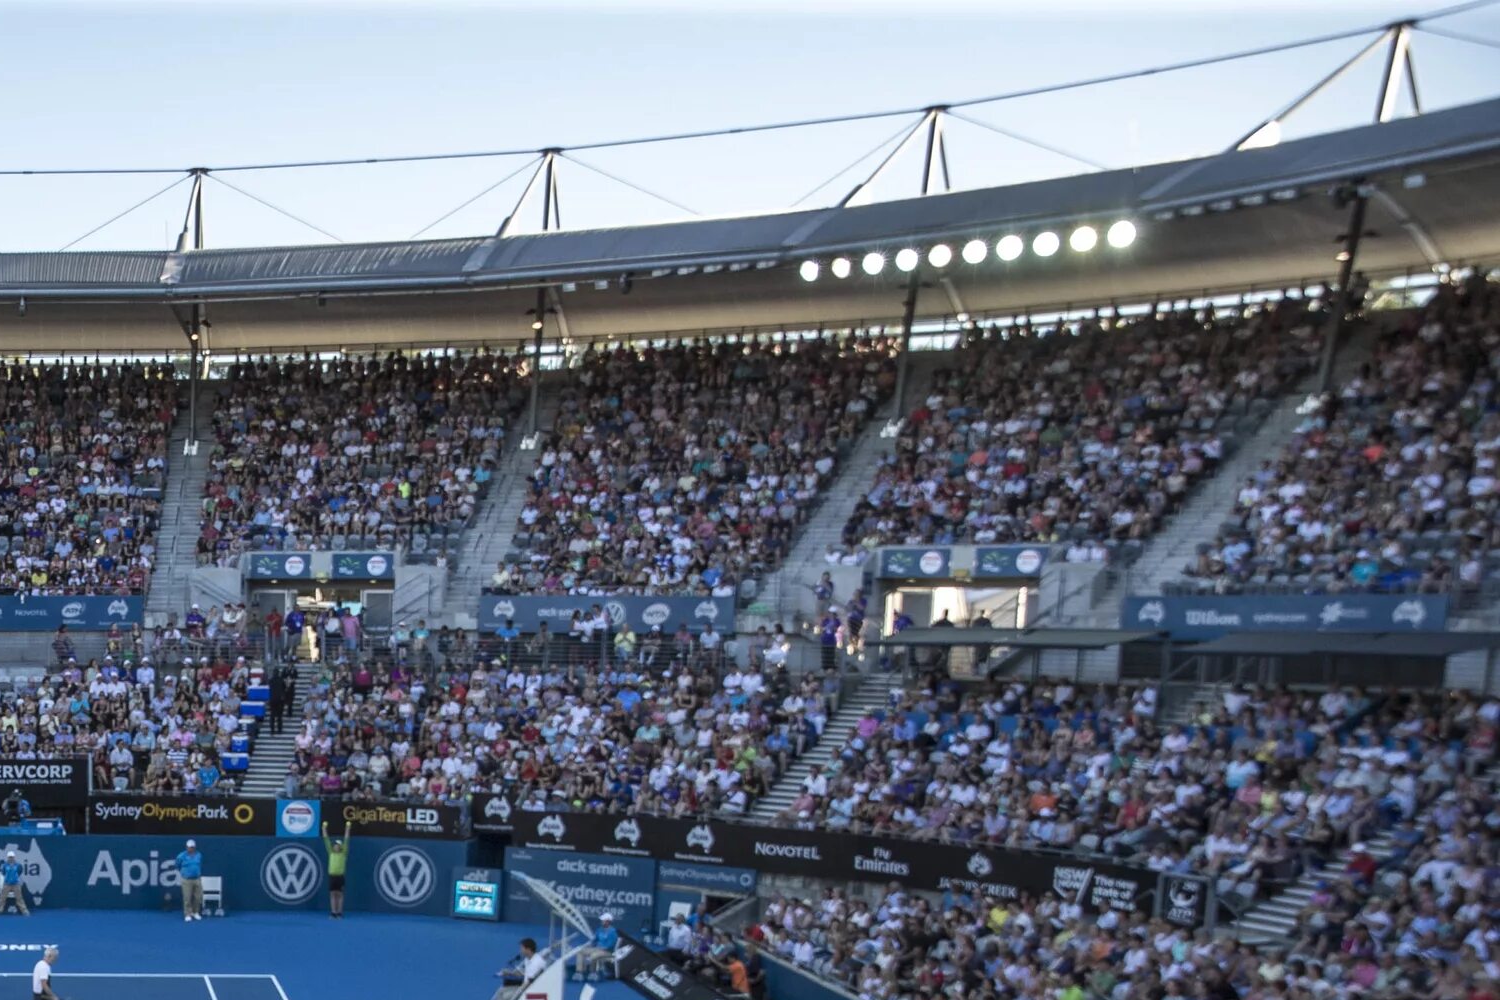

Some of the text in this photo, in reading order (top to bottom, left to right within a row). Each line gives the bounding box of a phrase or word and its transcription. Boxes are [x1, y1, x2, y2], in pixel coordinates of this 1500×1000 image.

[95, 802, 229, 820] SydneyOlympicPark
[754, 841, 822, 860] NOVOTEL
[874, 847, 891, 859] Fly
[87, 850, 181, 894] Apia
[557, 859, 629, 877] dick smith
[854, 857, 909, 876] Emirates
[1055, 866, 1085, 880] NSW
[459, 895, 493, 911] 0:22
[557, 885, 652, 907] sydney.com
[576, 903, 625, 916] ERVCORP
